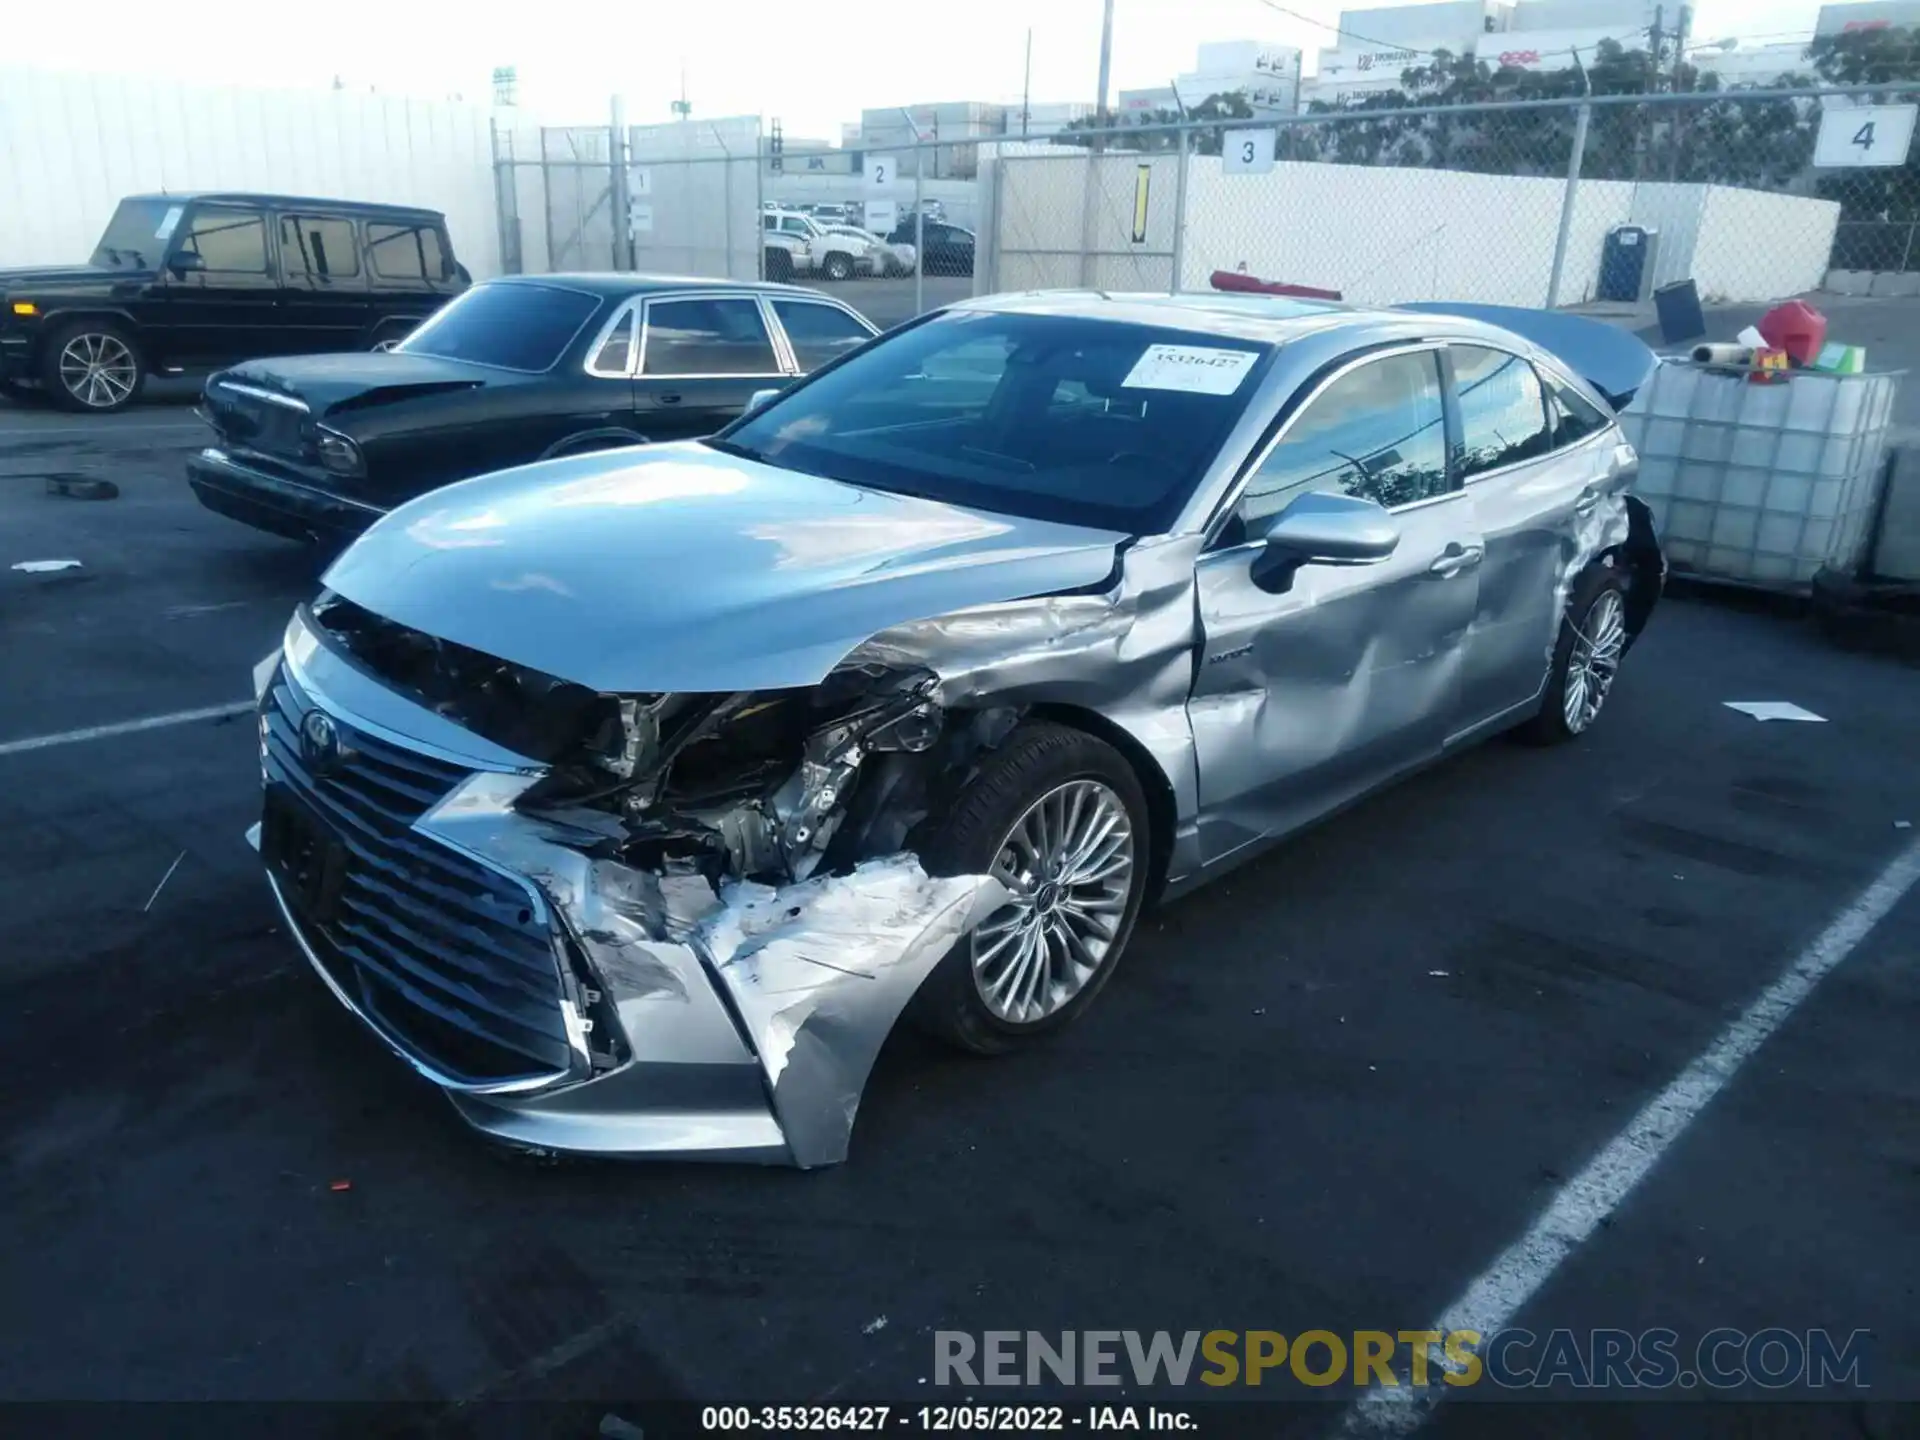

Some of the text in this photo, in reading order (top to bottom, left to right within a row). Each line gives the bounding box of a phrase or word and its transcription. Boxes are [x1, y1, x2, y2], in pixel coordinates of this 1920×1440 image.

[1852, 121, 1876, 151] 4
[1242, 141, 1255, 164] 3
[876, 165, 885, 184] 2
